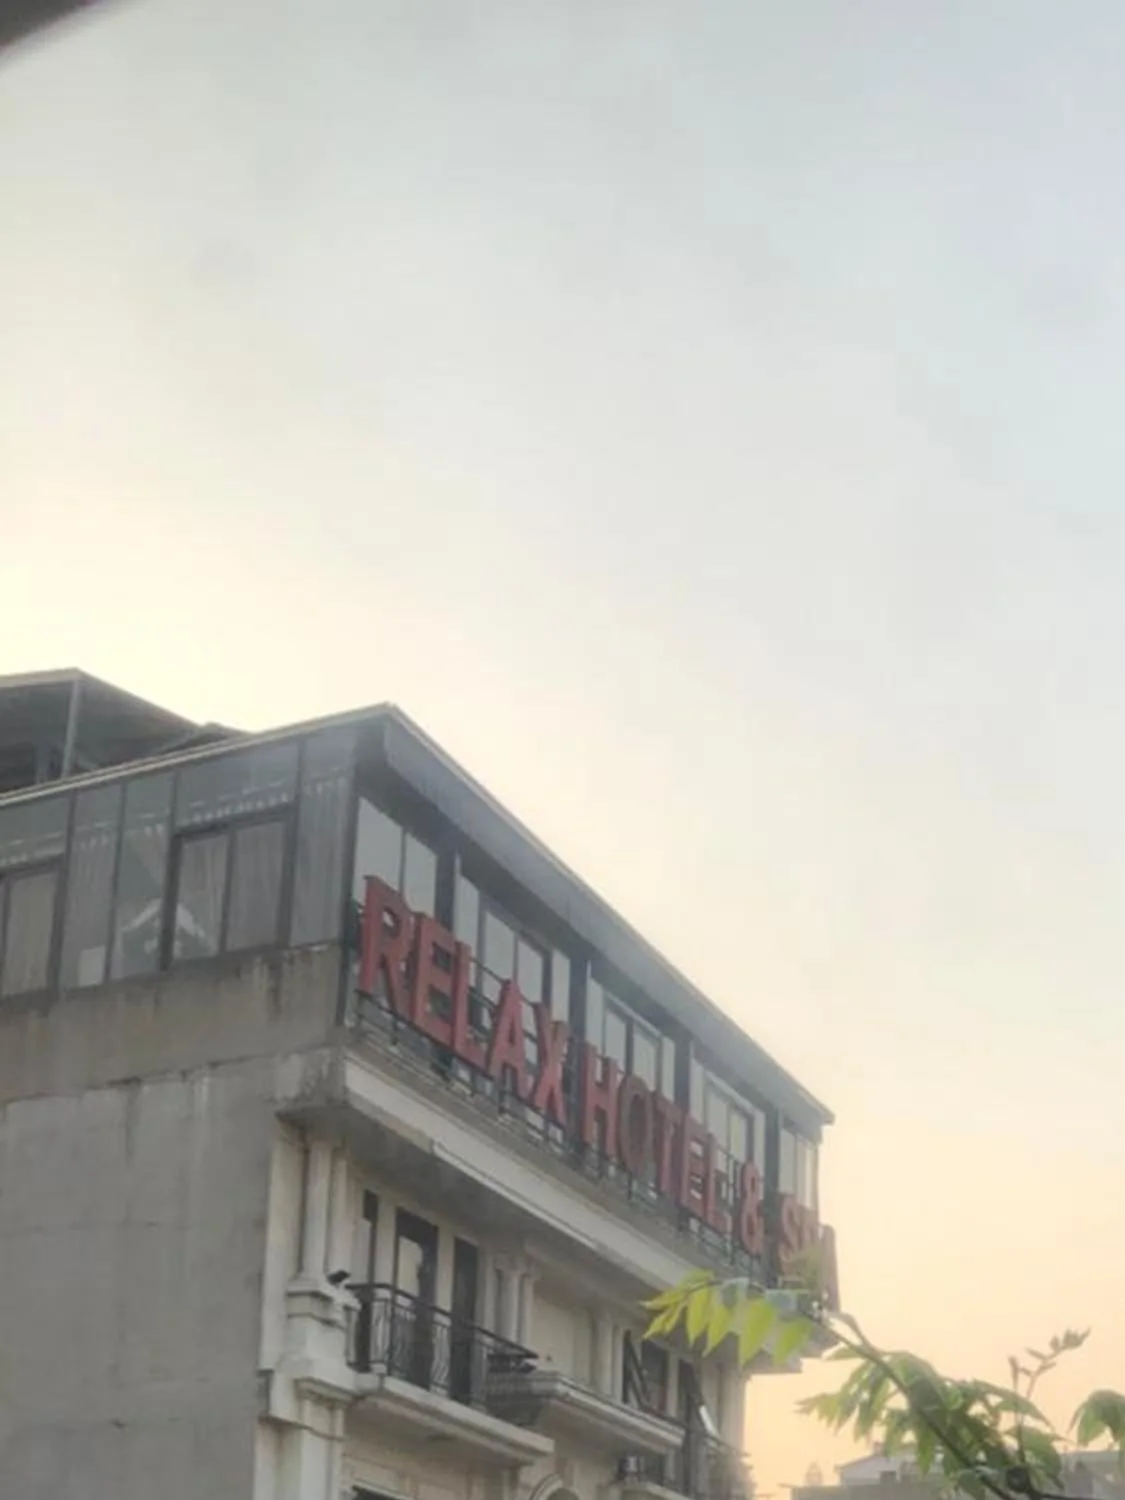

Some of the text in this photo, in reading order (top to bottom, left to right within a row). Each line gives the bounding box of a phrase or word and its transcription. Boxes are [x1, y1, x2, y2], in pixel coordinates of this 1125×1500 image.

[361, 875, 569, 1126] RELAX
[582, 1044, 733, 1231] HOTEL
[739, 1161, 765, 1257] &
